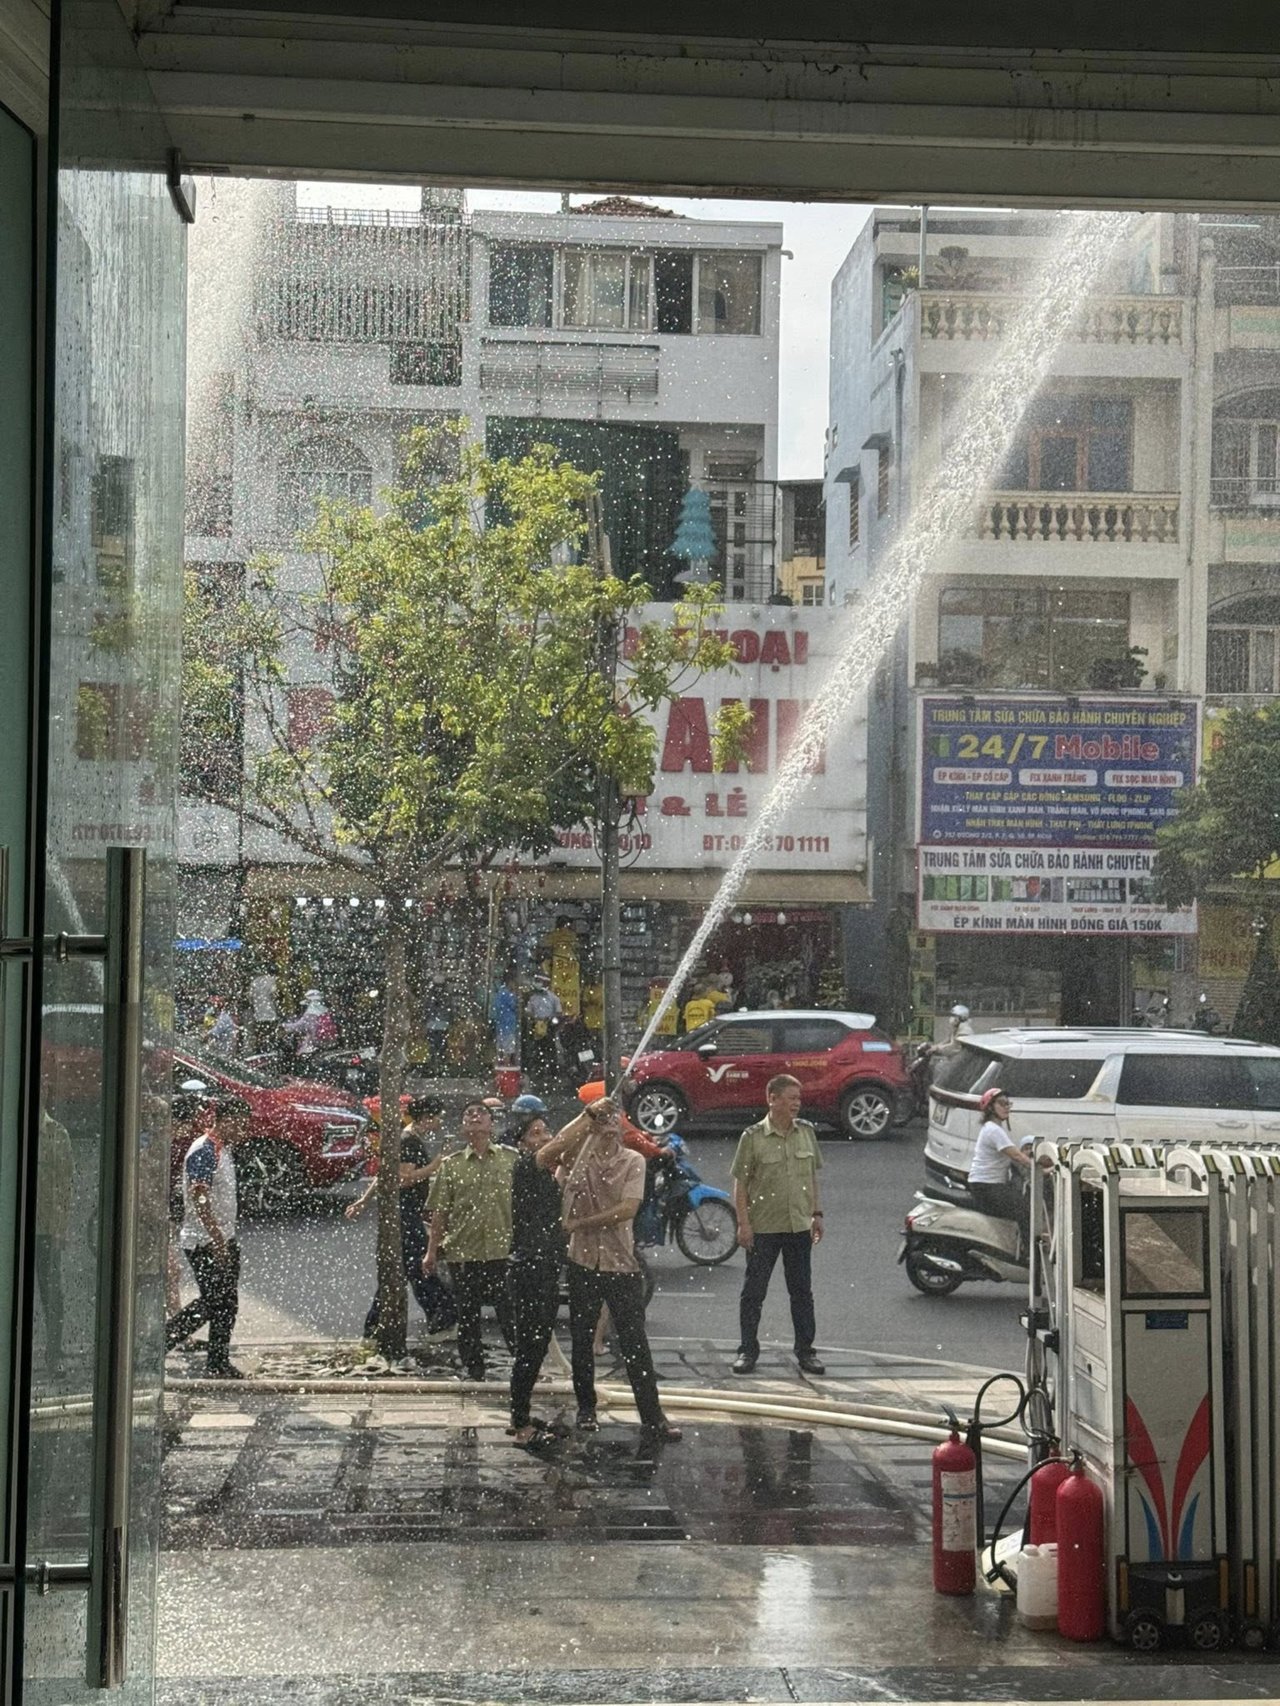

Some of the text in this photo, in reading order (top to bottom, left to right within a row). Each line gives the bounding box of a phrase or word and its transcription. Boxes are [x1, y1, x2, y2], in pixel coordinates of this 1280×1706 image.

[932, 709, 965, 721] TRUNG
[971, 708, 991, 722] TÂM
[1072, 711, 1101, 724] HÀNH
[1105, 709, 1144, 725] CHUYÊN
[1149, 712, 1186, 727] NGHIỆP
[958, 733, 1159, 764] 24/7 Mobile
[661, 796, 691, 816] &
[705, 787, 747, 818] LẺ
[924, 848, 1150, 870] TRUNG TÂM SỬA CHỮA BẢO HÀNH CHUYÊN
[954, 916, 969, 928] ÉP
[973, 915, 1002, 928] KÍNH
[1006, 916, 1034, 928] MÀN
[1038, 916, 1067, 929] HÌNH
[1108, 917, 1128, 930] GIÁ
[1134, 920, 1162, 930] 150K
